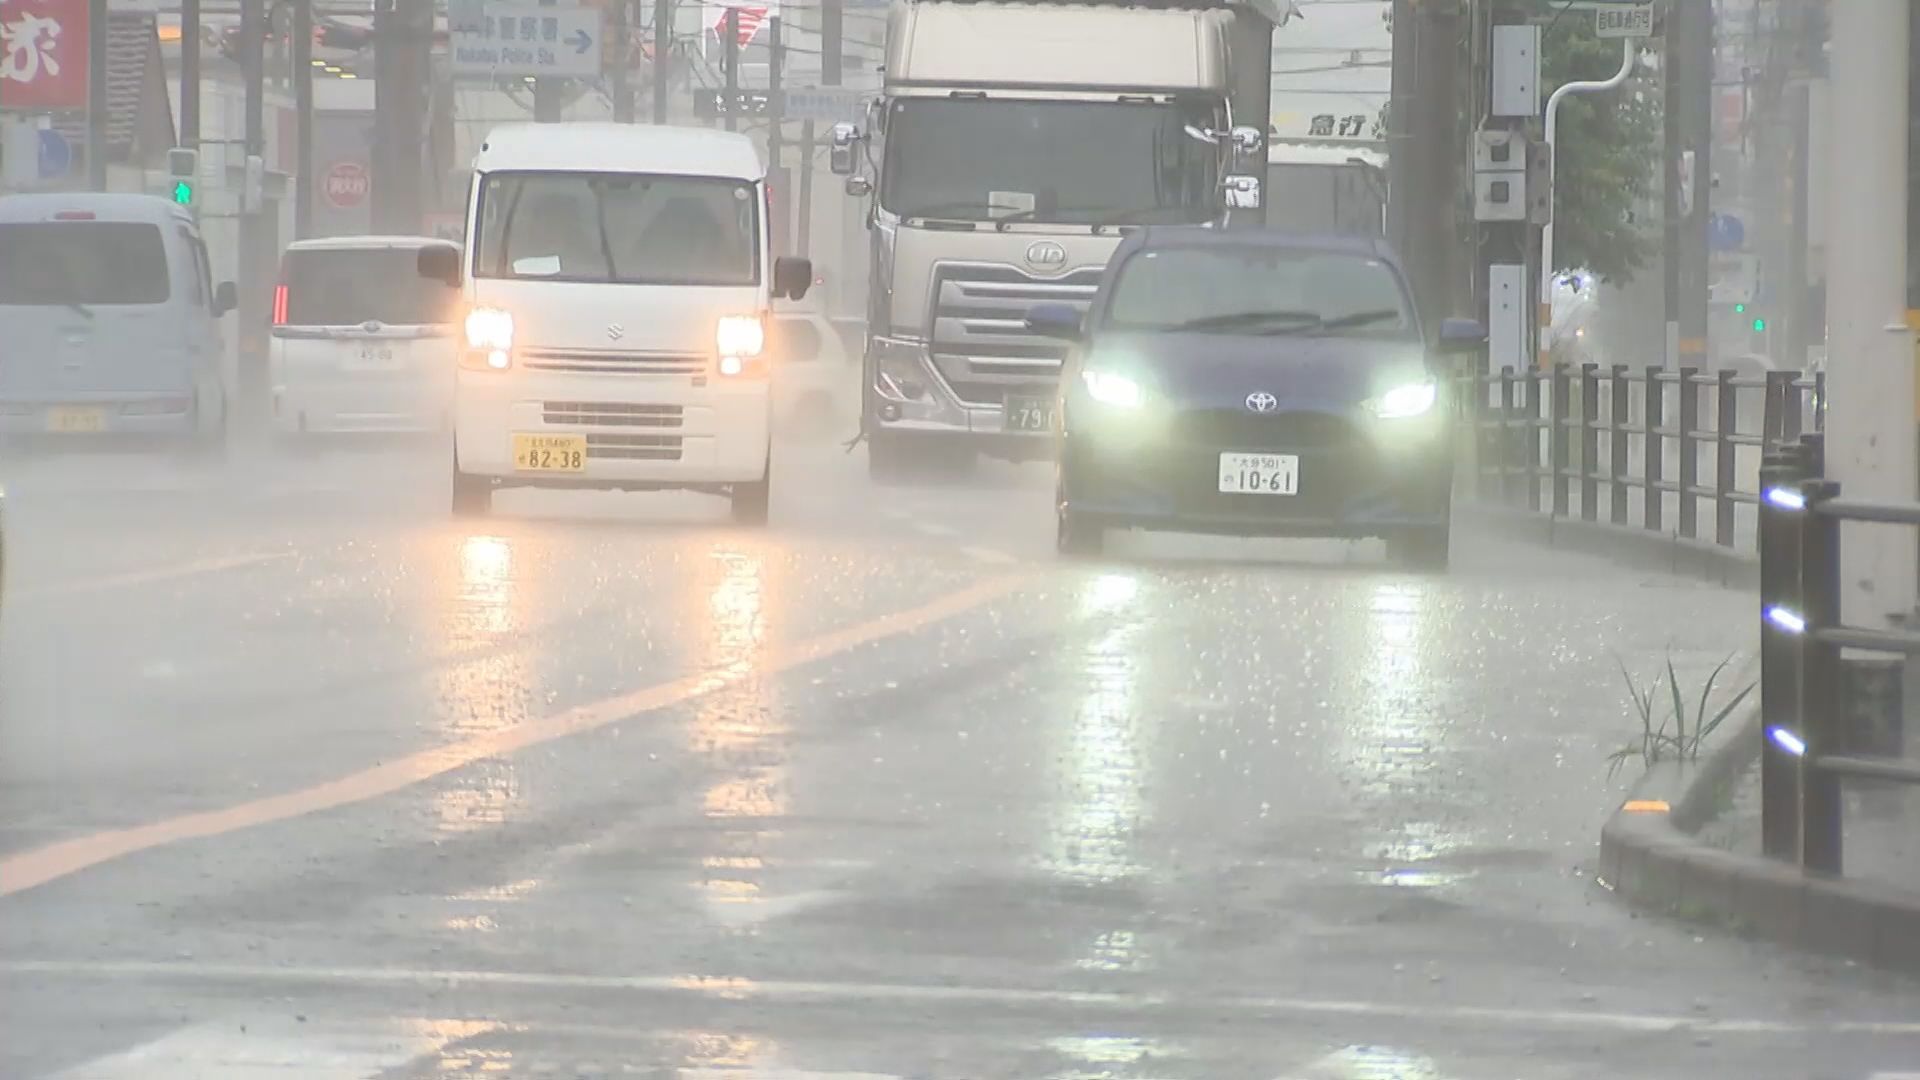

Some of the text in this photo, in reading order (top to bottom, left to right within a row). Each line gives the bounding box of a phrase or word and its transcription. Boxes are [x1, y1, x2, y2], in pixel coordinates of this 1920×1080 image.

[1308, 114, 1366, 136] 急行
[529, 449, 581, 468] 82-38
[1240, 470, 1291, 492] 10-61
